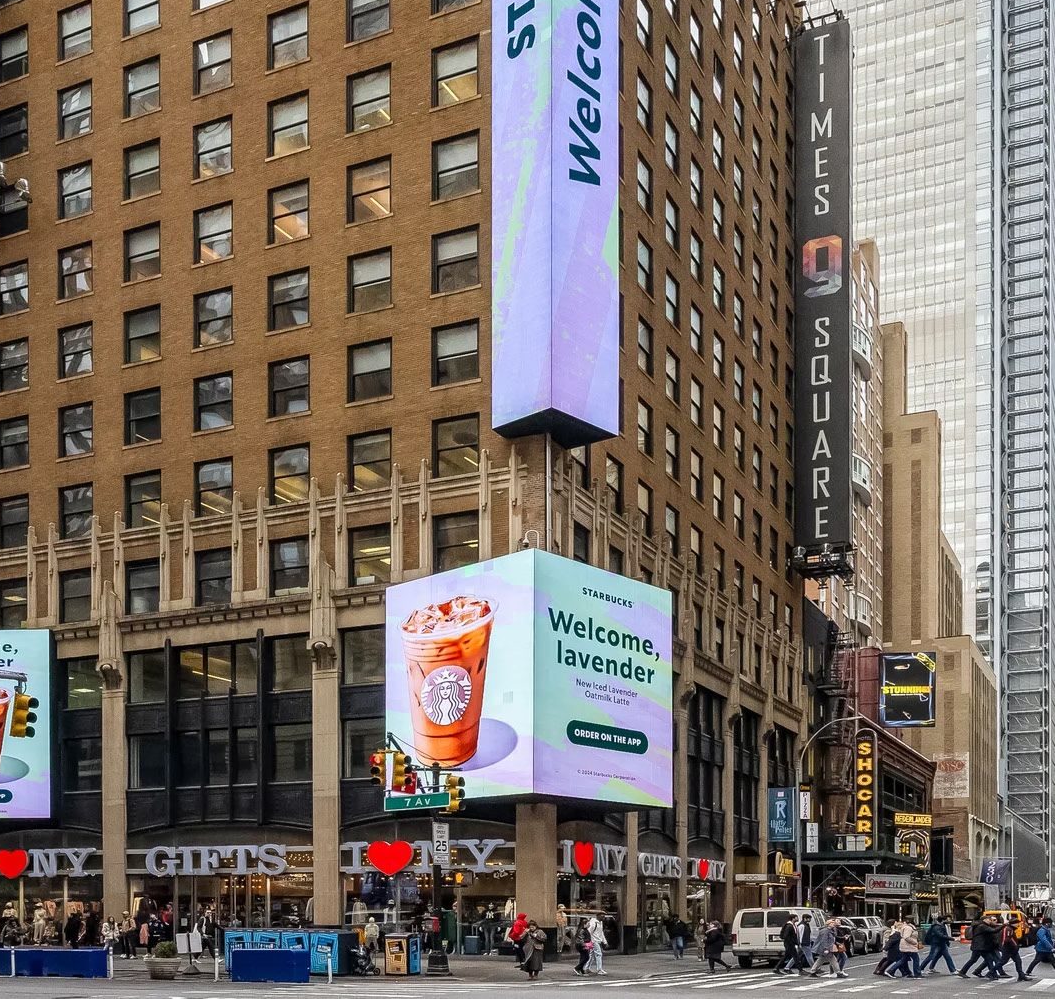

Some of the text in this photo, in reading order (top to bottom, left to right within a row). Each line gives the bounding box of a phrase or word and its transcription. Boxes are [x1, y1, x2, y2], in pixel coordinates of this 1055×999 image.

[809, 34, 834, 216] TIMES
[810, 315, 833, 539] SQUARE
[547, 607, 660, 662] Welcome,
[557, 639, 655, 684] lavender
[576, 678, 638, 698] New Iced Lavender
[585, 690, 630, 706] Oatmilk Latte
[574, 728, 642, 747] ORDER ON THE APP
[857, 742, 873, 848] SHOCARD
[770, 819, 786, 830] Harry
[775, 826, 793, 835] Potter
[895, 814, 932, 825] NEDERLANDER
[345, 839, 506, 874] I NY
[435, 840, 448, 852] 25
[560, 839, 628, 877] I NY
[28, 848, 97, 878] NY
[145, 843, 288, 877] GIFTS
[639, 852, 683, 879] GIFTS
[688, 857, 727, 882] I NY
[985, 861, 996, 883] 230
[888, 881, 908, 889] PIZZA
